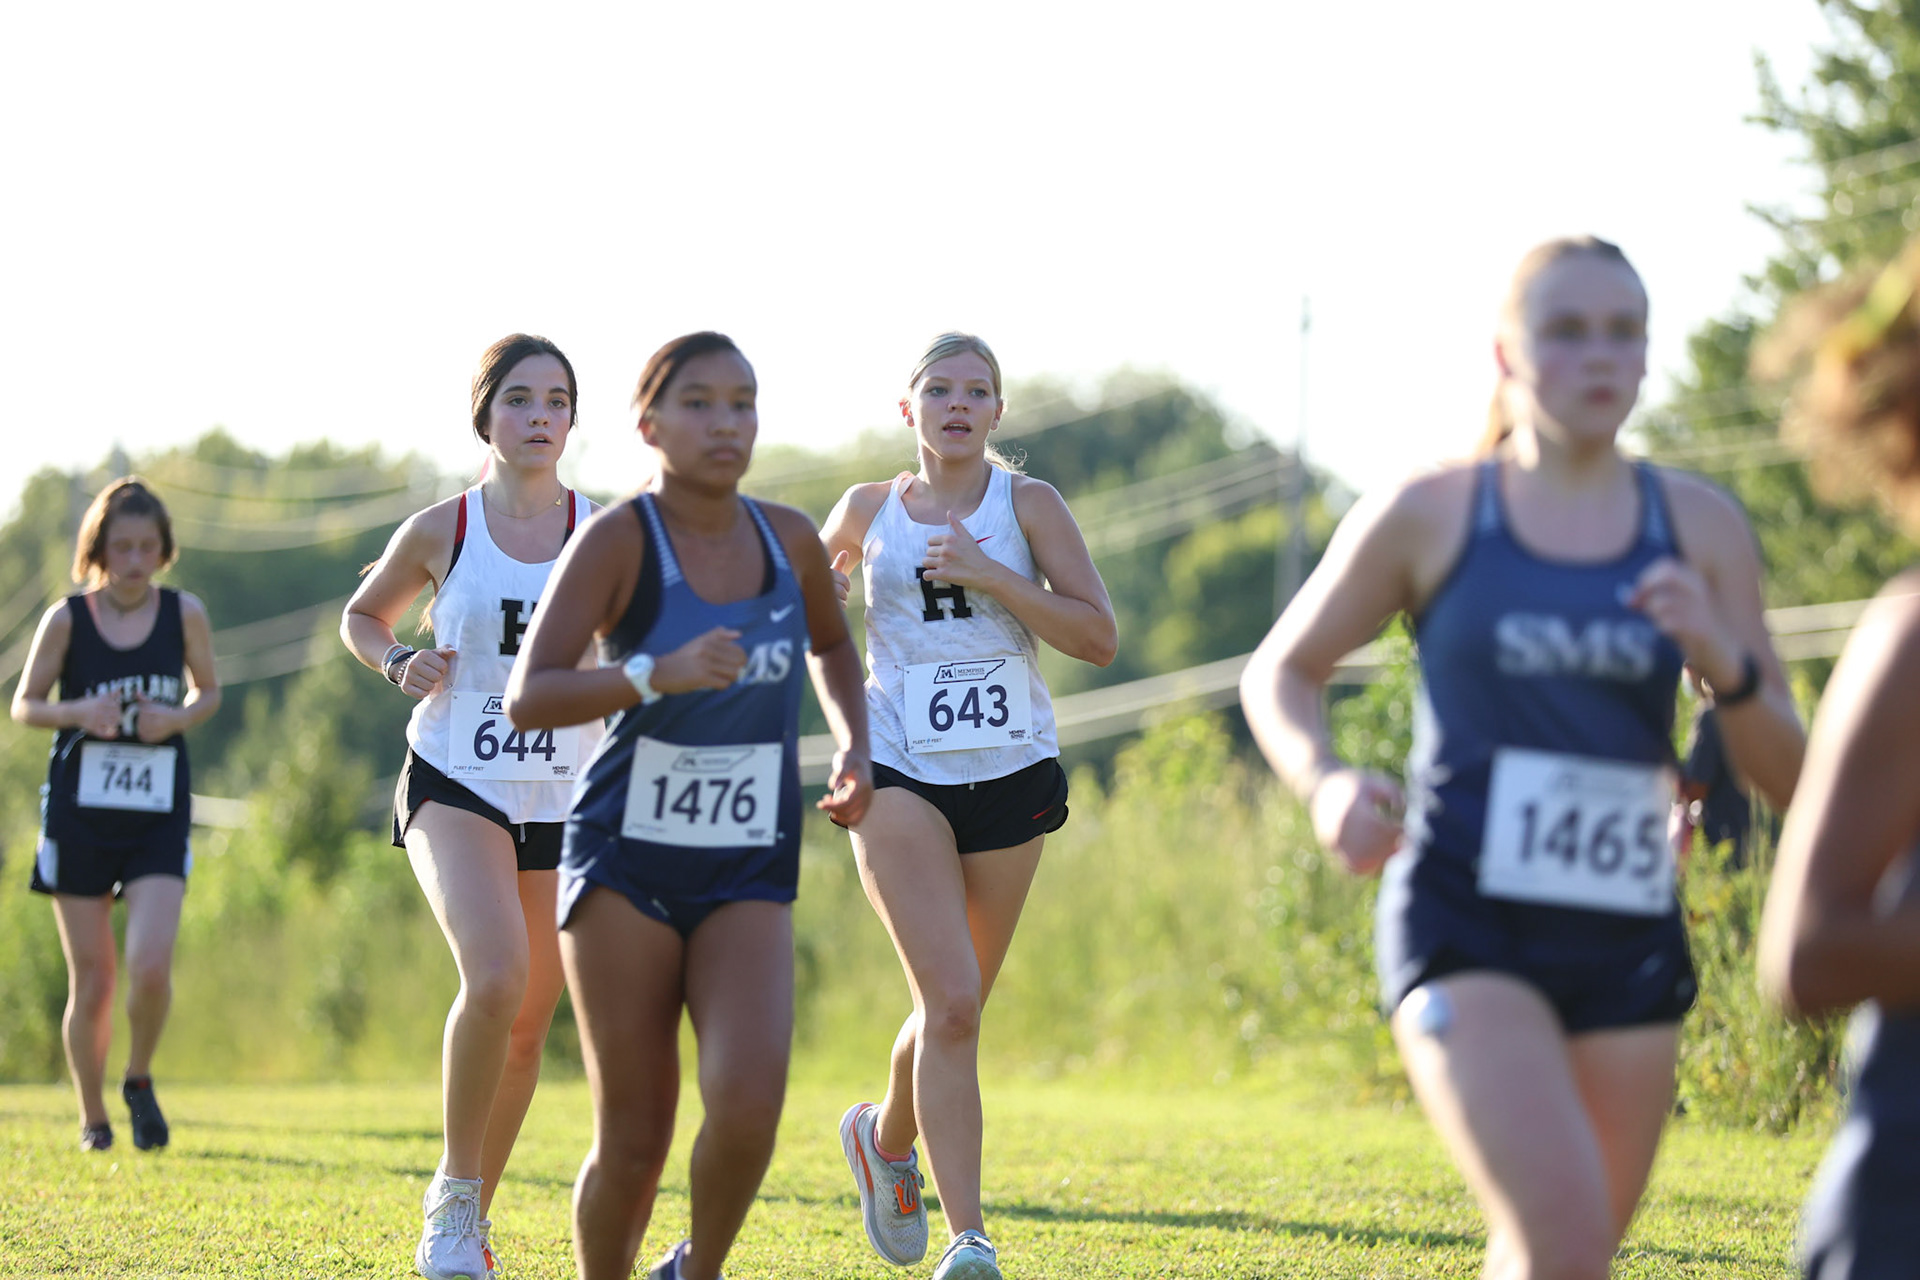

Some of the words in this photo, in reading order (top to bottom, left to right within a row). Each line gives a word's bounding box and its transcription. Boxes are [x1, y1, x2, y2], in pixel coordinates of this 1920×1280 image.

[916, 567, 972, 622] H
[498, 598, 542, 657] H
[1497, 612, 1656, 682] SMS
[737, 639, 793, 685] MS
[929, 684, 1009, 732] 643
[473, 719, 556, 762] 644
[102, 760, 153, 796] 744
[652, 774, 757, 825] 1476
[1517, 801, 1662, 879] 1465
